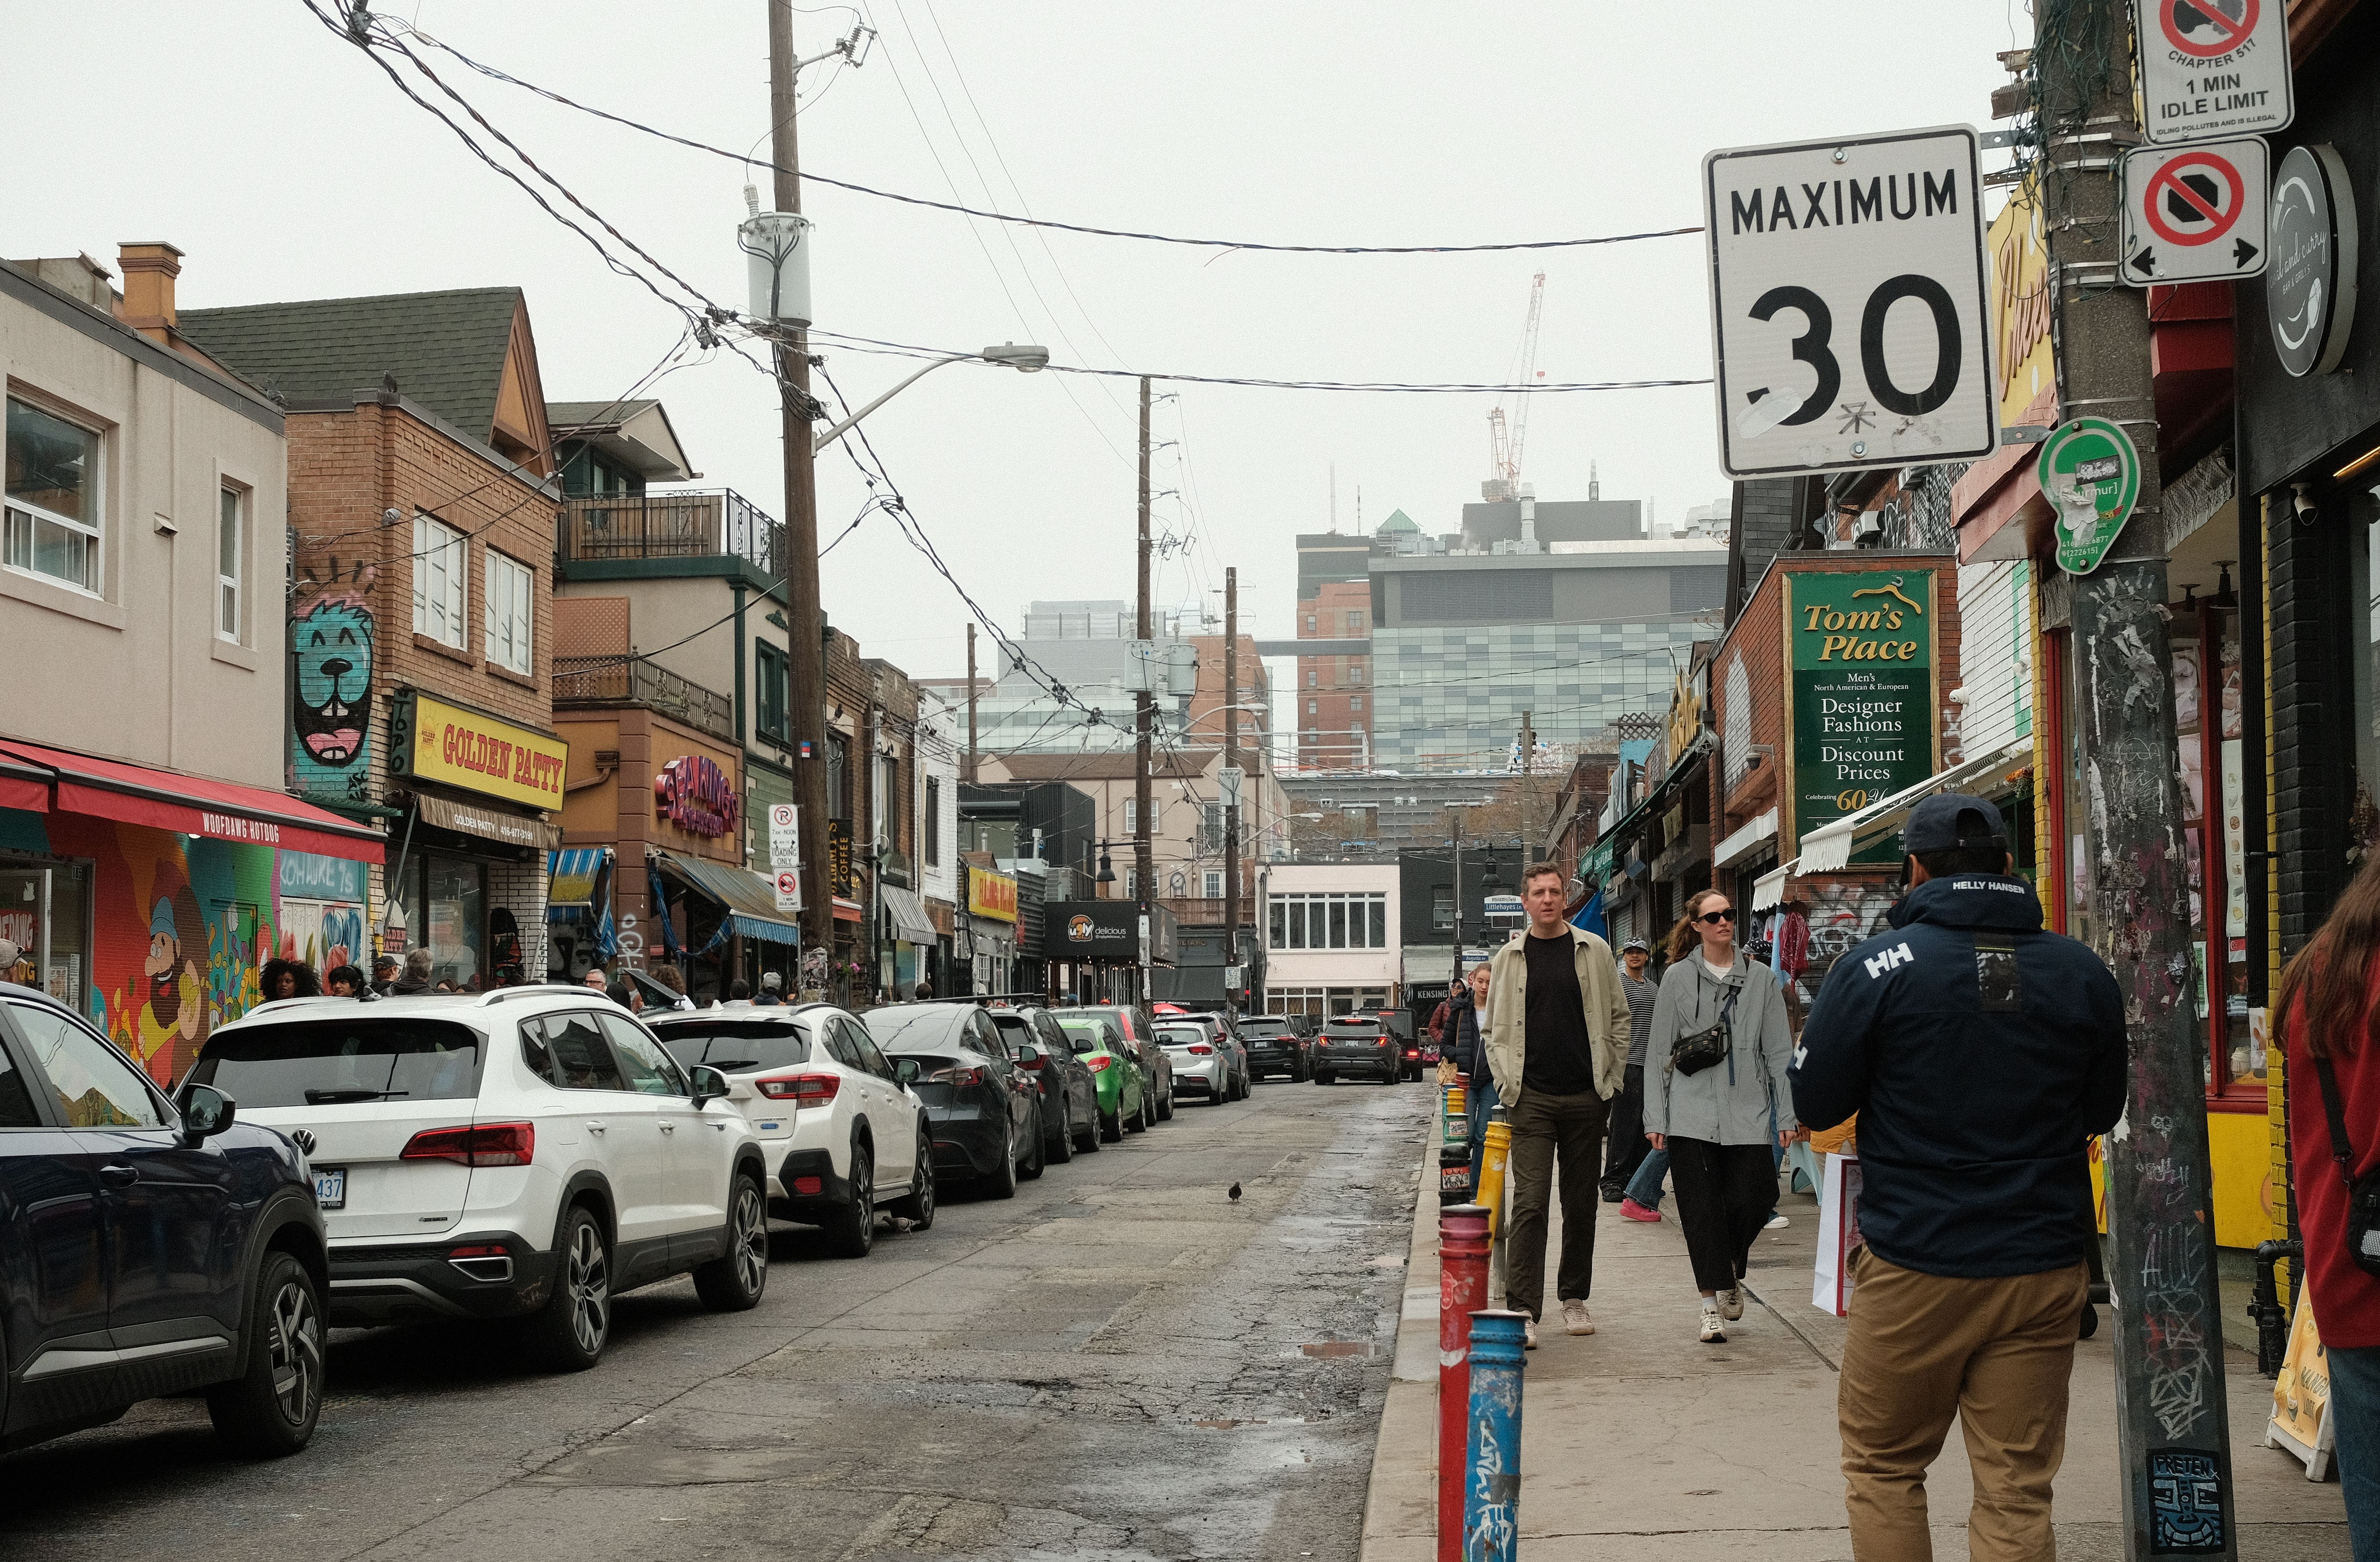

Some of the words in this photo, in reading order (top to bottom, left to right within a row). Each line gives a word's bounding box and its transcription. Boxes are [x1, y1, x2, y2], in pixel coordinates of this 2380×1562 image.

[2168, 50, 2234, 69] CHAPTER
[2236, 38, 2256, 58] 517
[2186, 79, 2194, 94] 1
[2203, 73, 2241, 93] MIN
[2161, 98, 2208, 120] IDLE
[2215, 91, 2269, 112] LIMIT
[2156, 127, 2180, 135] IDLING
[2182, 121, 2219, 132] POLLUTES
[2220, 118, 2236, 127] AND
[2246, 114, 2277, 123] ILLEGAL
[1731, 168, 1958, 236] MAXIMUM
[2285, 232, 2300, 273] and
[2302, 232, 2327, 265] curry
[2282, 280, 2292, 295] BAR
[1747, 273, 1962, 426] 30
[1804, 603, 1904, 631] Tom's
[1817, 635, 1918, 661] Place
[1814, 683, 1834, 691] North
[1877, 683, 1909, 692] European
[1847, 673, 1875, 683] Men's
[1821, 697, 1903, 718] Designer
[421, 730, 436, 739] GOLDEN
[1822, 716, 1902, 733] Fashions
[443, 723, 512, 780] GOLDEN
[513, 745, 563, 794] PATTY
[1821, 746, 1904, 763] Discount
[1836, 764, 1890, 781] Prices
[1837, 789, 1867, 811] 60
[202, 813, 247, 838] WOOFDAWG
[249, 821, 280, 843] HOTDOG
[454, 814, 477, 829] GOLDEN
[477, 820, 496, 833] PATTY
[500, 825, 534, 841] 416-977-3191
[840, 837, 848, 883] COFFEE
[1953, 881, 1986, 890] HELLY
[1988, 881, 2025, 894] HANSEN
[1069, 922, 1093, 937] ugly
[1095, 926, 1126, 935] delicious
[1863, 942, 1915, 979] HH
[317, 1179, 342, 1198] 437
